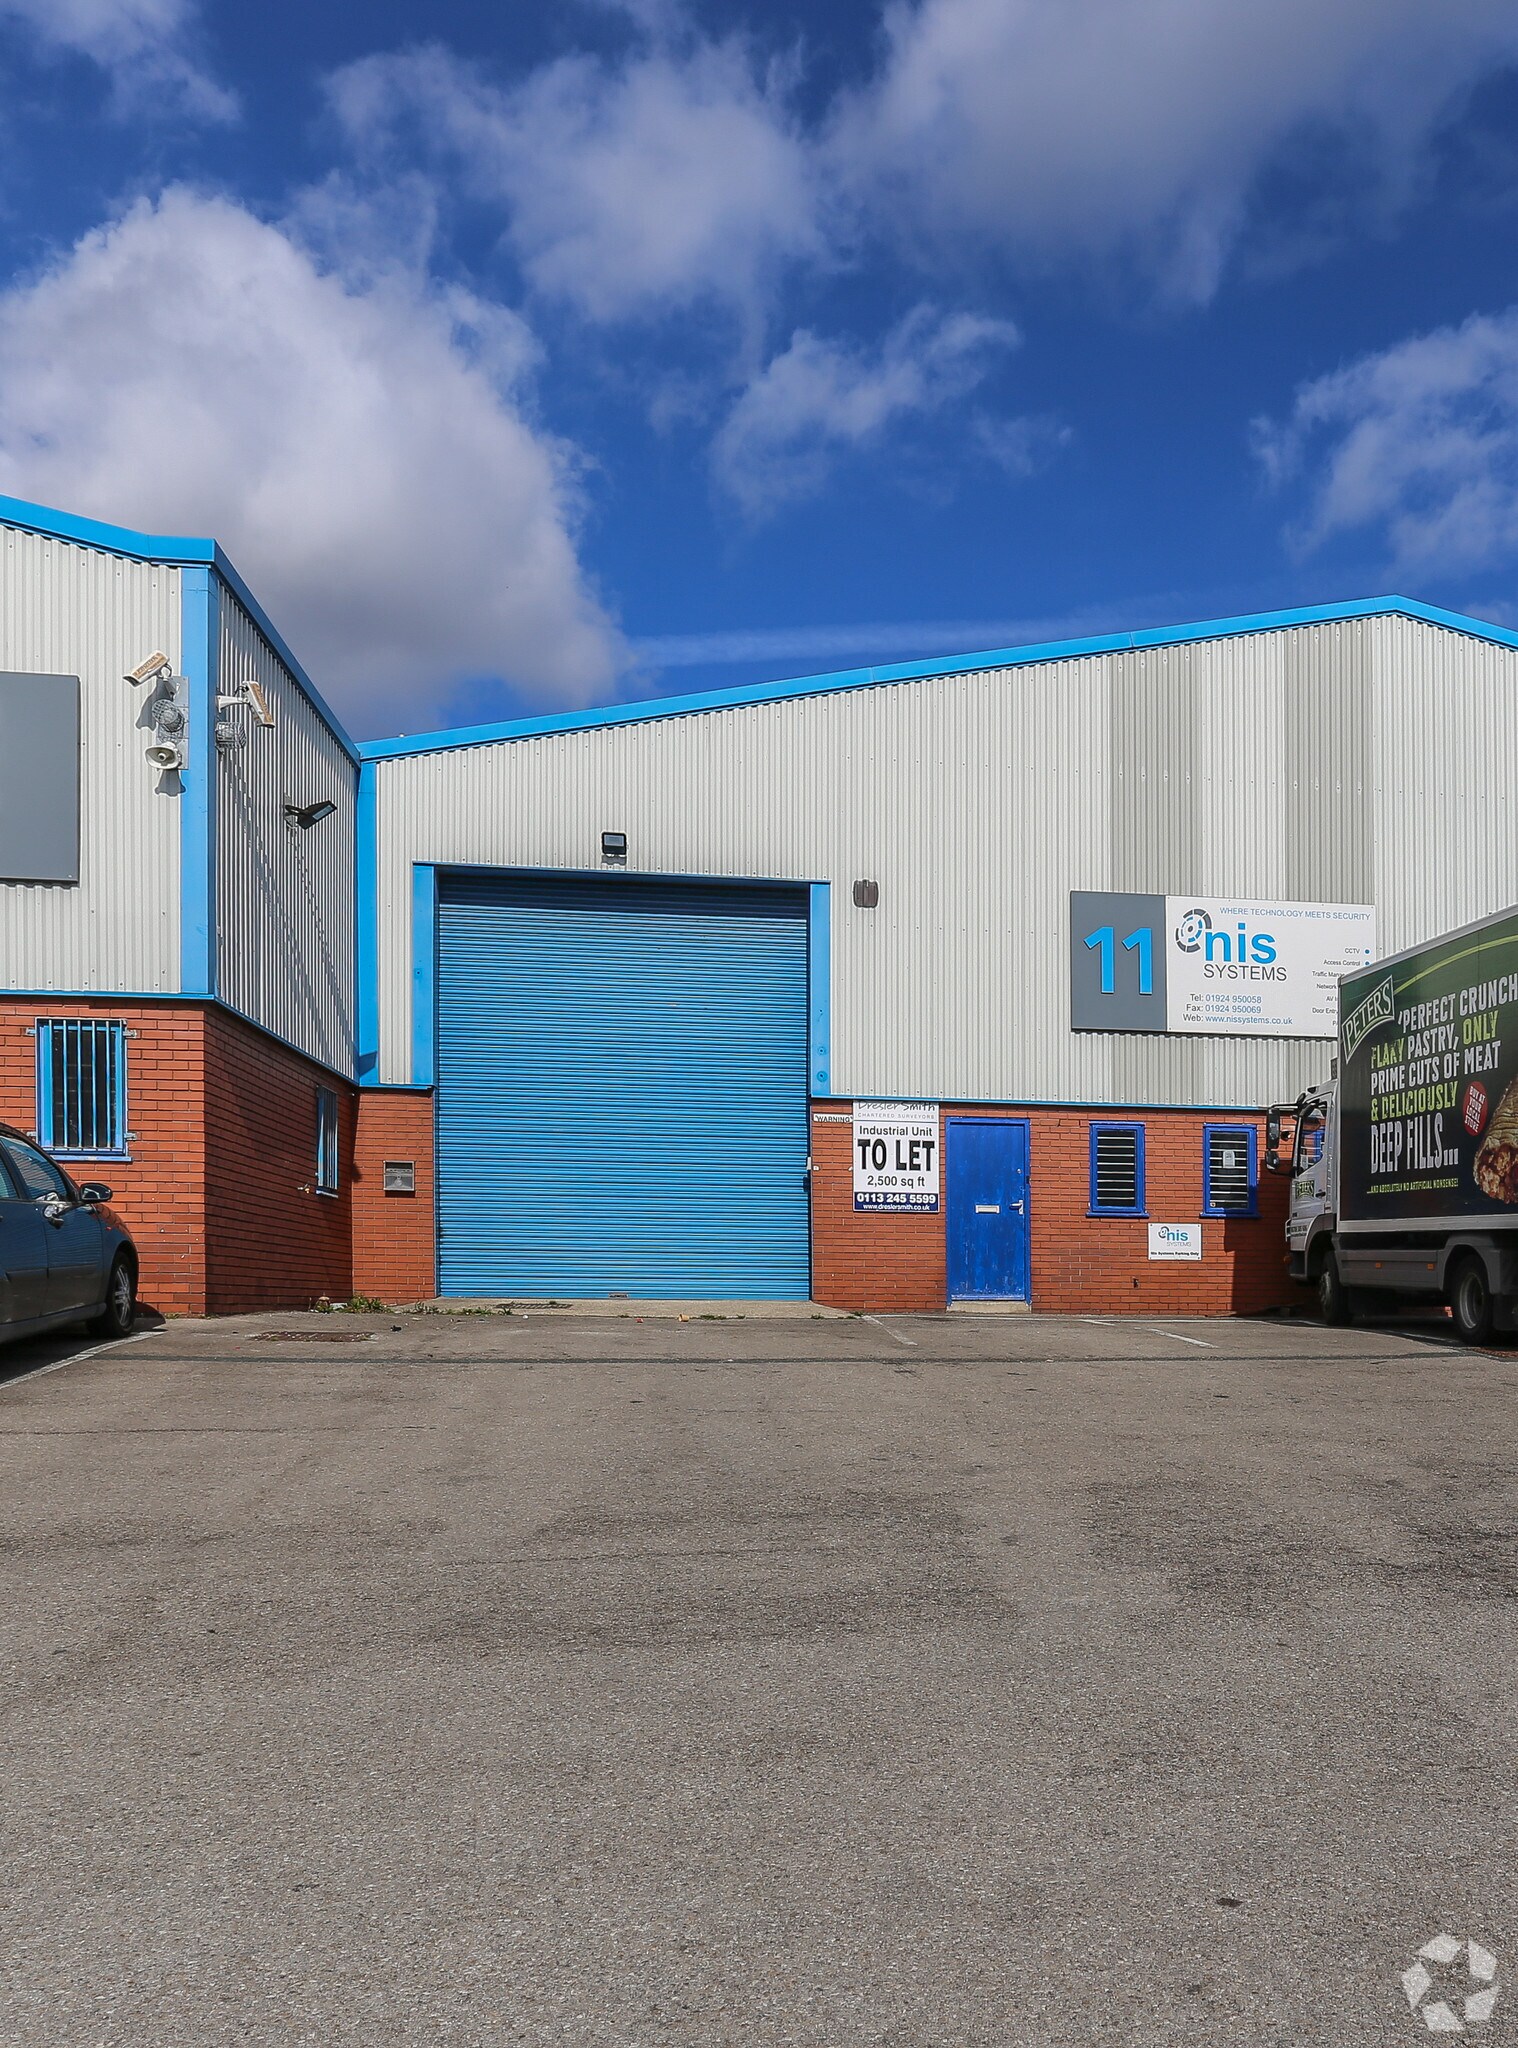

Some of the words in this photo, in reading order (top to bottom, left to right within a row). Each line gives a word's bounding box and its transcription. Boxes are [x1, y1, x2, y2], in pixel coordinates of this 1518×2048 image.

[1219, 907, 1249, 916] WHERE
[1250, 908, 1304, 918] TECHNOLOGY
[1305, 910, 1331, 919] MEETS
[1332, 912, 1371, 921] SECURITY
[1344, 947, 1361, 955] CCTV
[1083, 926, 1153, 995] 11
[1323, 959, 1342, 967] Access
[1203, 963, 1287, 982] SYSTEMS
[1189, 993, 1204, 1002] Tel:
[1205, 994, 1230, 1003] 01924
[1231, 995, 1262, 1004] 950058
[1186, 1004, 1204, 1012] Fax:
[1205, 1004, 1230, 1013] 01924
[1231, 1005, 1262, 1014] 950069
[1344, 982, 1392, 1052] PETER'S
[1183, 1013, 1204, 1022] Web:
[1205, 1015, 1293, 1025] www.nissystems.co.uk
[1370, 1037, 1406, 1070] FLAKY
[1406, 1022, 1460, 1060] PASTRY,
[1462, 1009, 1499, 1045] ONLY
[1370, 1064, 1406, 1096] PRIME
[1407, 1057, 1440, 1087] CUTS
[1443, 1051, 1460, 1079] OF
[1464, 1040, 1502, 1075] MEAT
[1370, 1097, 1379, 1122] &
[1381, 1080, 1459, 1120] DELICIOUSLY
[1469, 1085, 1480, 1100] BUY
[1478, 1093, 1486, 1105] AT
[1469, 1096, 1482, 1113] YOUR
[1466, 1105, 1481, 1123] LOCAL
[859, 1125, 909, 1136] Industrial
[911, 1126, 933, 1137] Unit
[1464, 1114, 1479, 1133] STORE
[857, 1138, 887, 1171] TO
[895, 1139, 935, 1172] LET
[1370, 1120, 1403, 1174] DEEP
[867, 1175, 898, 1188] 2,500
[900, 1178, 914, 1189] sq
[917, 1176, 925, 1187] ft
[1410, 1180, 1433, 1191] ARTIFICIAL
[856, 1193, 884, 1202] 0113
[886, 1194, 907, 1203] 245
[909, 1194, 936, 1204] 5599
[862, 1203, 931, 1211] www.dreslersmith.co.uk
